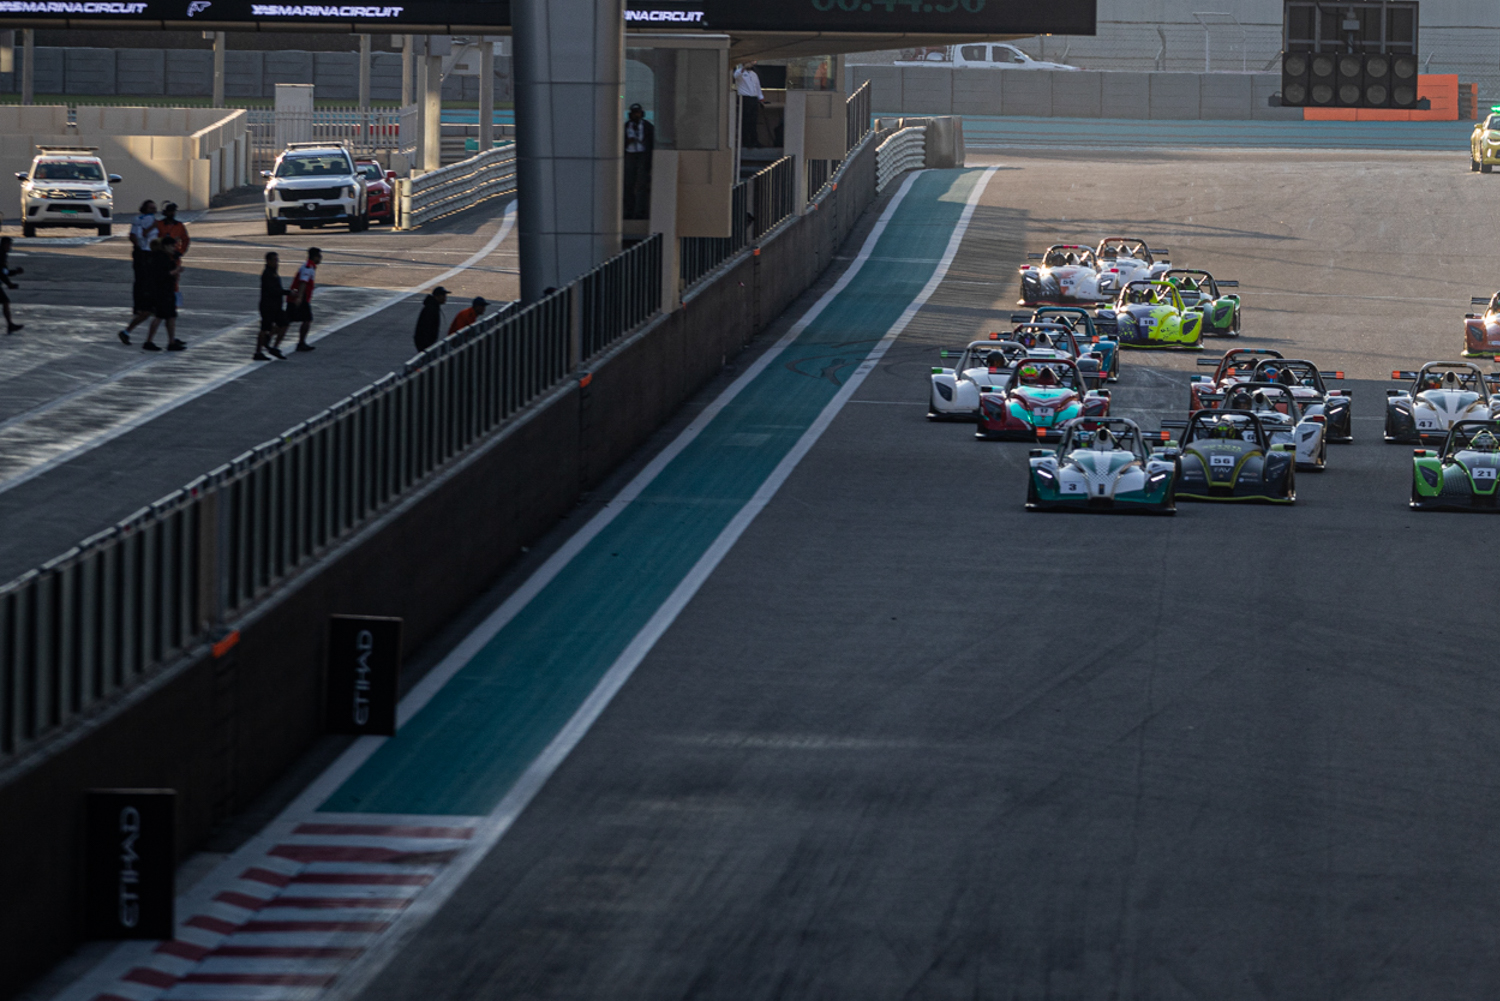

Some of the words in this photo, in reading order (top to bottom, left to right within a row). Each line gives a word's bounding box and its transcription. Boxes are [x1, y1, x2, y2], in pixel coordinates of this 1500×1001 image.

[1068, 483, 1077, 491] 3
[1476, 470, 1492, 478] 21
[353, 629, 373, 725] ETIHAD
[118, 806, 140, 928] ETIHAD
